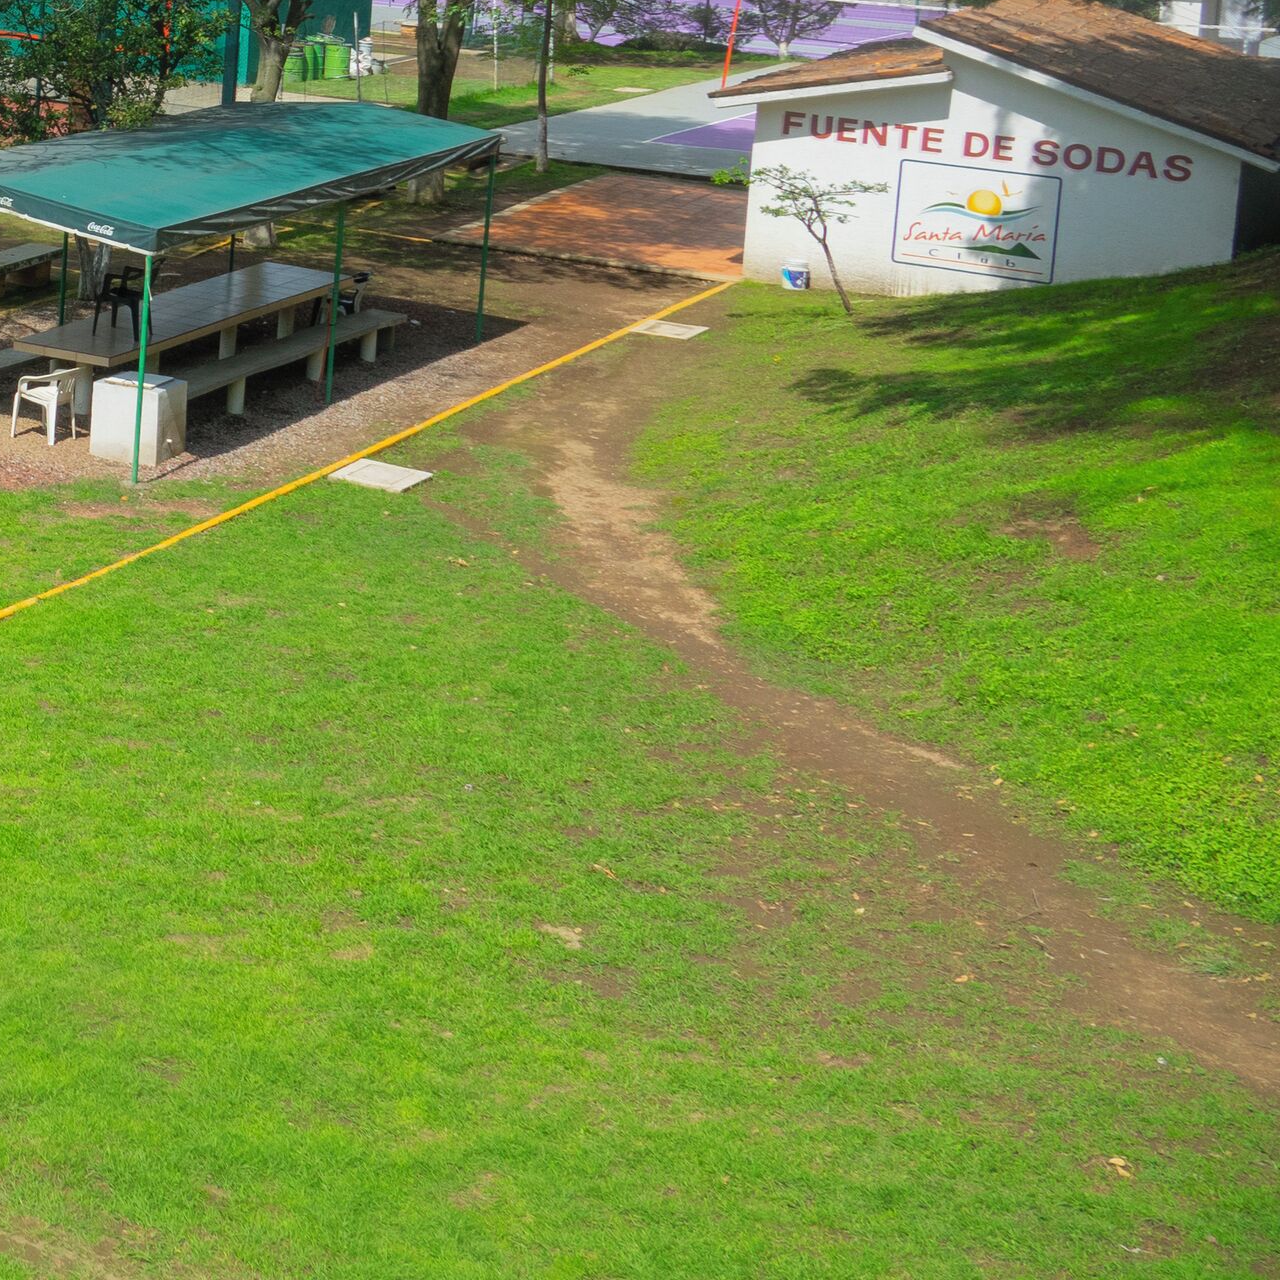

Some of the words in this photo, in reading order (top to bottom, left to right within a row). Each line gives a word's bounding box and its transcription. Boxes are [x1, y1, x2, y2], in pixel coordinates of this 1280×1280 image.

[782, 111, 944, 153] FUENTE
[963, 131, 1015, 162] DE
[1032, 140, 1194, 182] SODAS
[903, 222, 963, 241] Santa
[972, 224, 1046, 241] María
